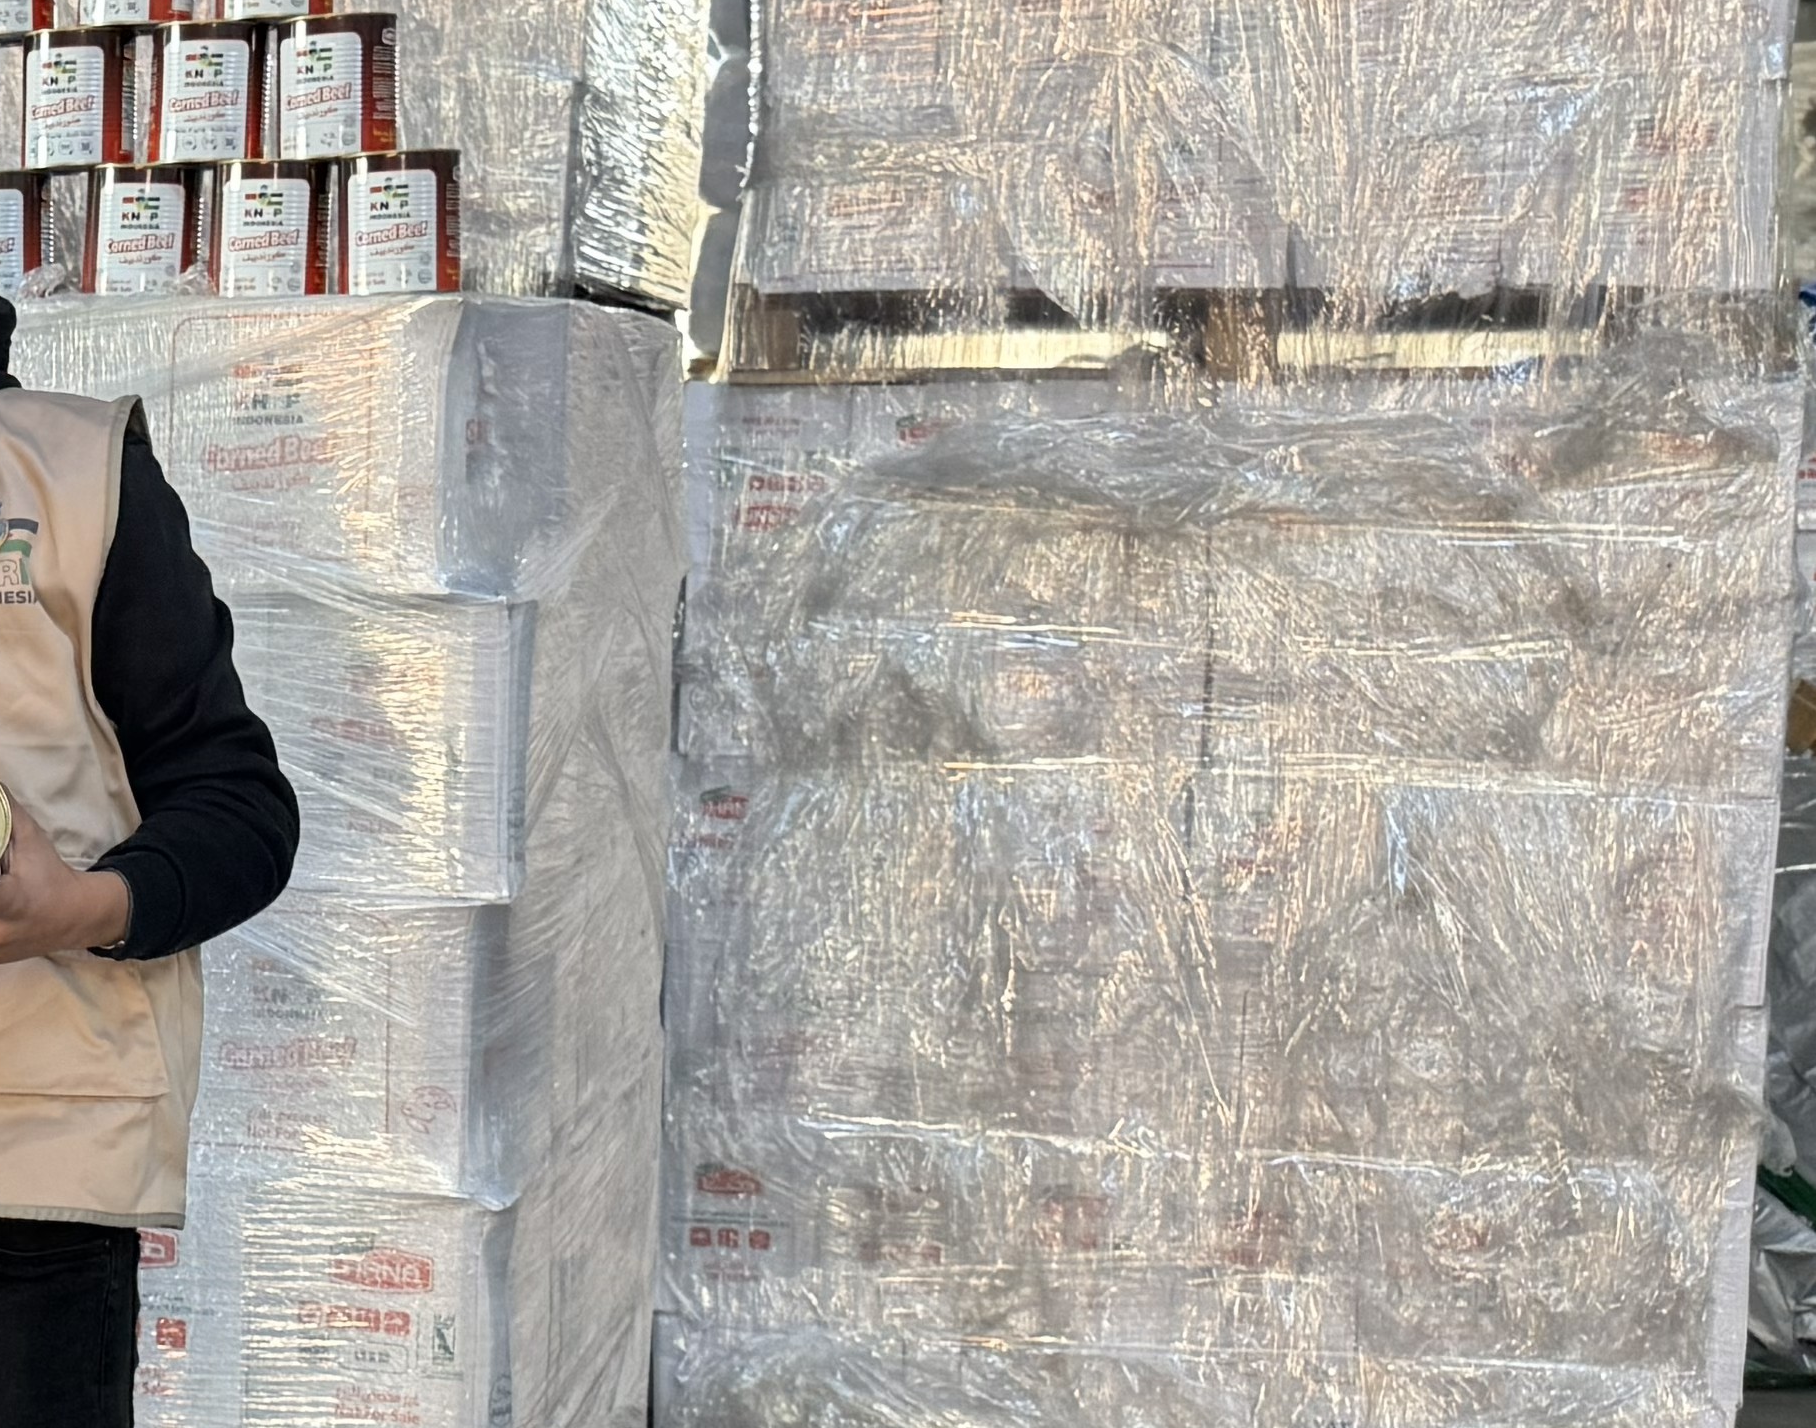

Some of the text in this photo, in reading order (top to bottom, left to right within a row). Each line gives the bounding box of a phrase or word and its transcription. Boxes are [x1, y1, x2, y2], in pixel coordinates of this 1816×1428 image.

[184, 68, 223, 79] KNP
[296, 63, 333, 76] KNP
[370, 200, 408, 211] KNP
[122, 211, 158, 222] KNP
[244, 208, 283, 219] KNP
